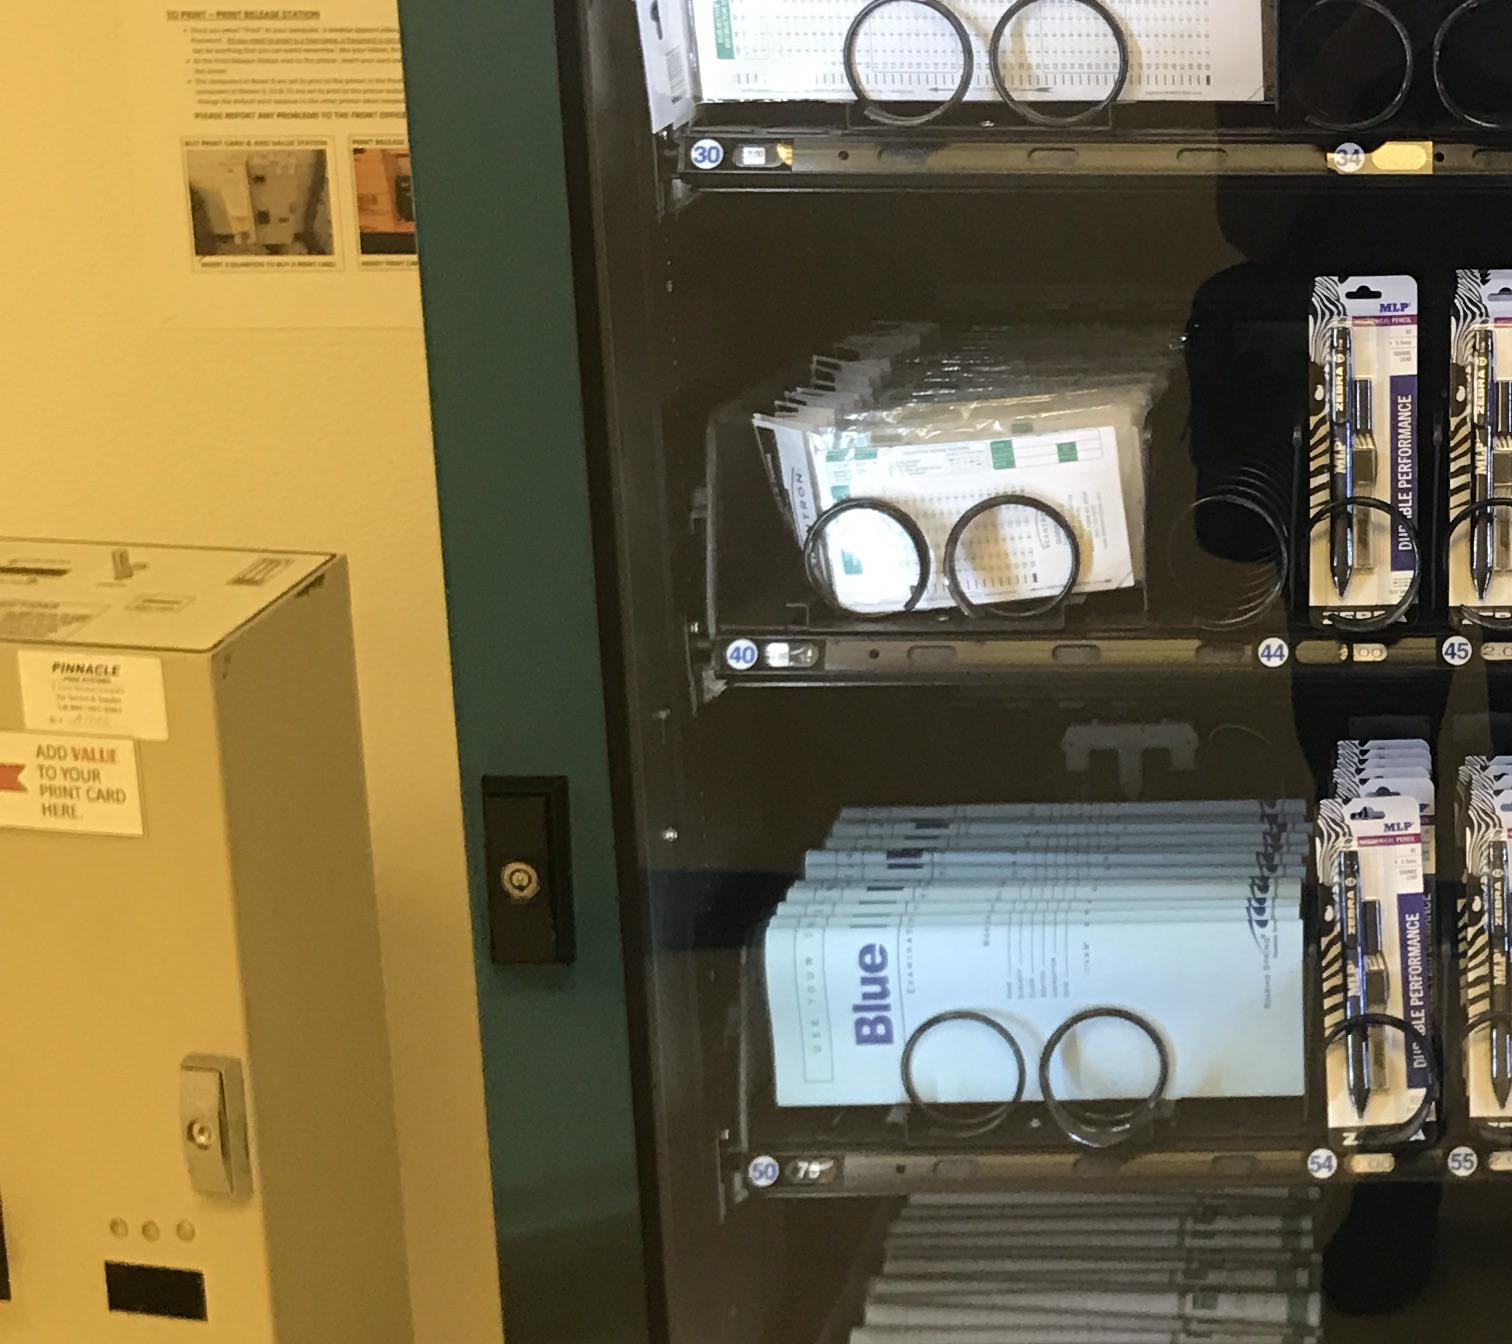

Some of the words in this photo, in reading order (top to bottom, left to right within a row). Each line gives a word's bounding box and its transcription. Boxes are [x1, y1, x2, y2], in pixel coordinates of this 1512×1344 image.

[694, 146, 720, 163] 30
[1336, 149, 1360, 166] 34
[1379, 303, 1408, 313] MLP
[1336, 364, 1344, 412] ZEBRA
[1477, 368, 1485, 414] ZEBRA
[1397, 395, 1412, 488] PERFORMANCE
[730, 647, 754, 664] 40
[1261, 643, 1285, 660] 44
[1445, 642, 1469, 660] 45
[52, 662, 120, 676] PINNACLE
[36, 744, 67, 761] ADD
[72, 748, 117, 763] VALUE
[38, 765, 56, 780] TO
[62, 767, 101, 783] YOUR
[40, 784, 80, 801] PRINT
[86, 787, 126, 804] CARD
[1409, 912, 1421, 1010] PERFORMANCE
[853, 943, 893, 1046] Blue
[1310, 1157, 1333, 1172] 54
[1451, 1154, 1473, 1171] 55
[753, 1163, 777, 1180] 50
